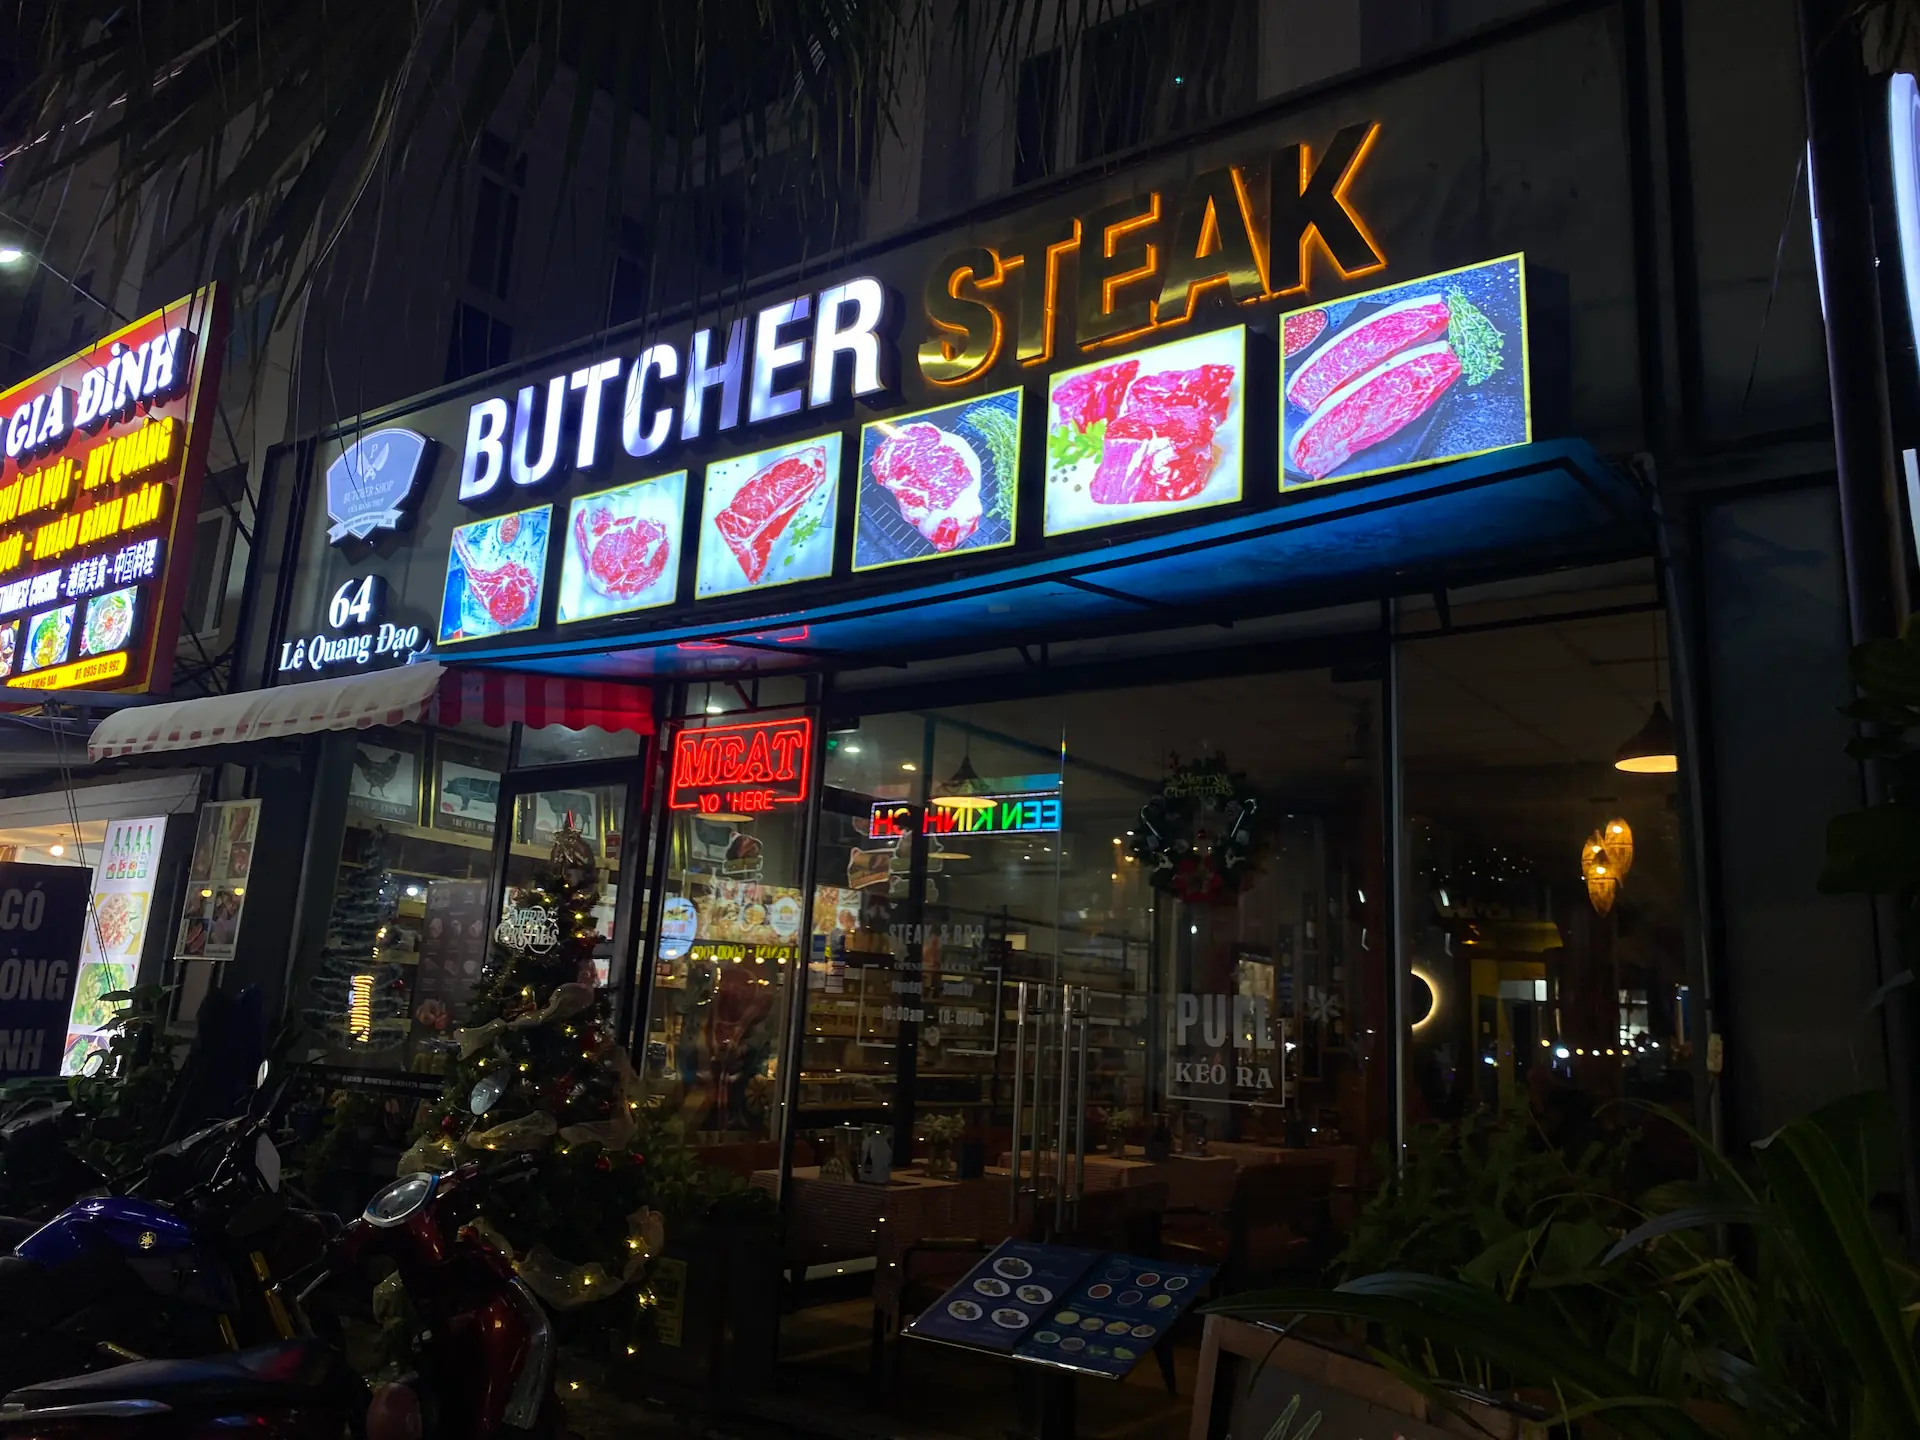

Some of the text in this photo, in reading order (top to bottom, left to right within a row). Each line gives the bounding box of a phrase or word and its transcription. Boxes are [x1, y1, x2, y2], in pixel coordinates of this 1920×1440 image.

[459, 121, 1387, 500] BUTCHER STEAK
[6, 327, 182, 457] GIA ĐÌNH
[0, 472, 23, 524] HỞ
[18, 466, 42, 516] HÀ
[39, 456, 73, 510] NỘI
[110, 416, 173, 483] QUẢNG
[374, 480, 394, 495] SHOP
[34, 513, 80, 559] NHẬU
[78, 502, 123, 545] BÌNH
[122, 482, 162, 530] DÂN
[329, 575, 373, 628] 64
[278, 623, 419, 671] Lê Quang Đạo
[677, 729, 803, 788] MEAT
[0, 881, 46, 932] CÓ
[889, 923, 932, 945] STEAK
[1177, 993, 1275, 1049] PULL
[1236, 1066, 1274, 1089] RA
